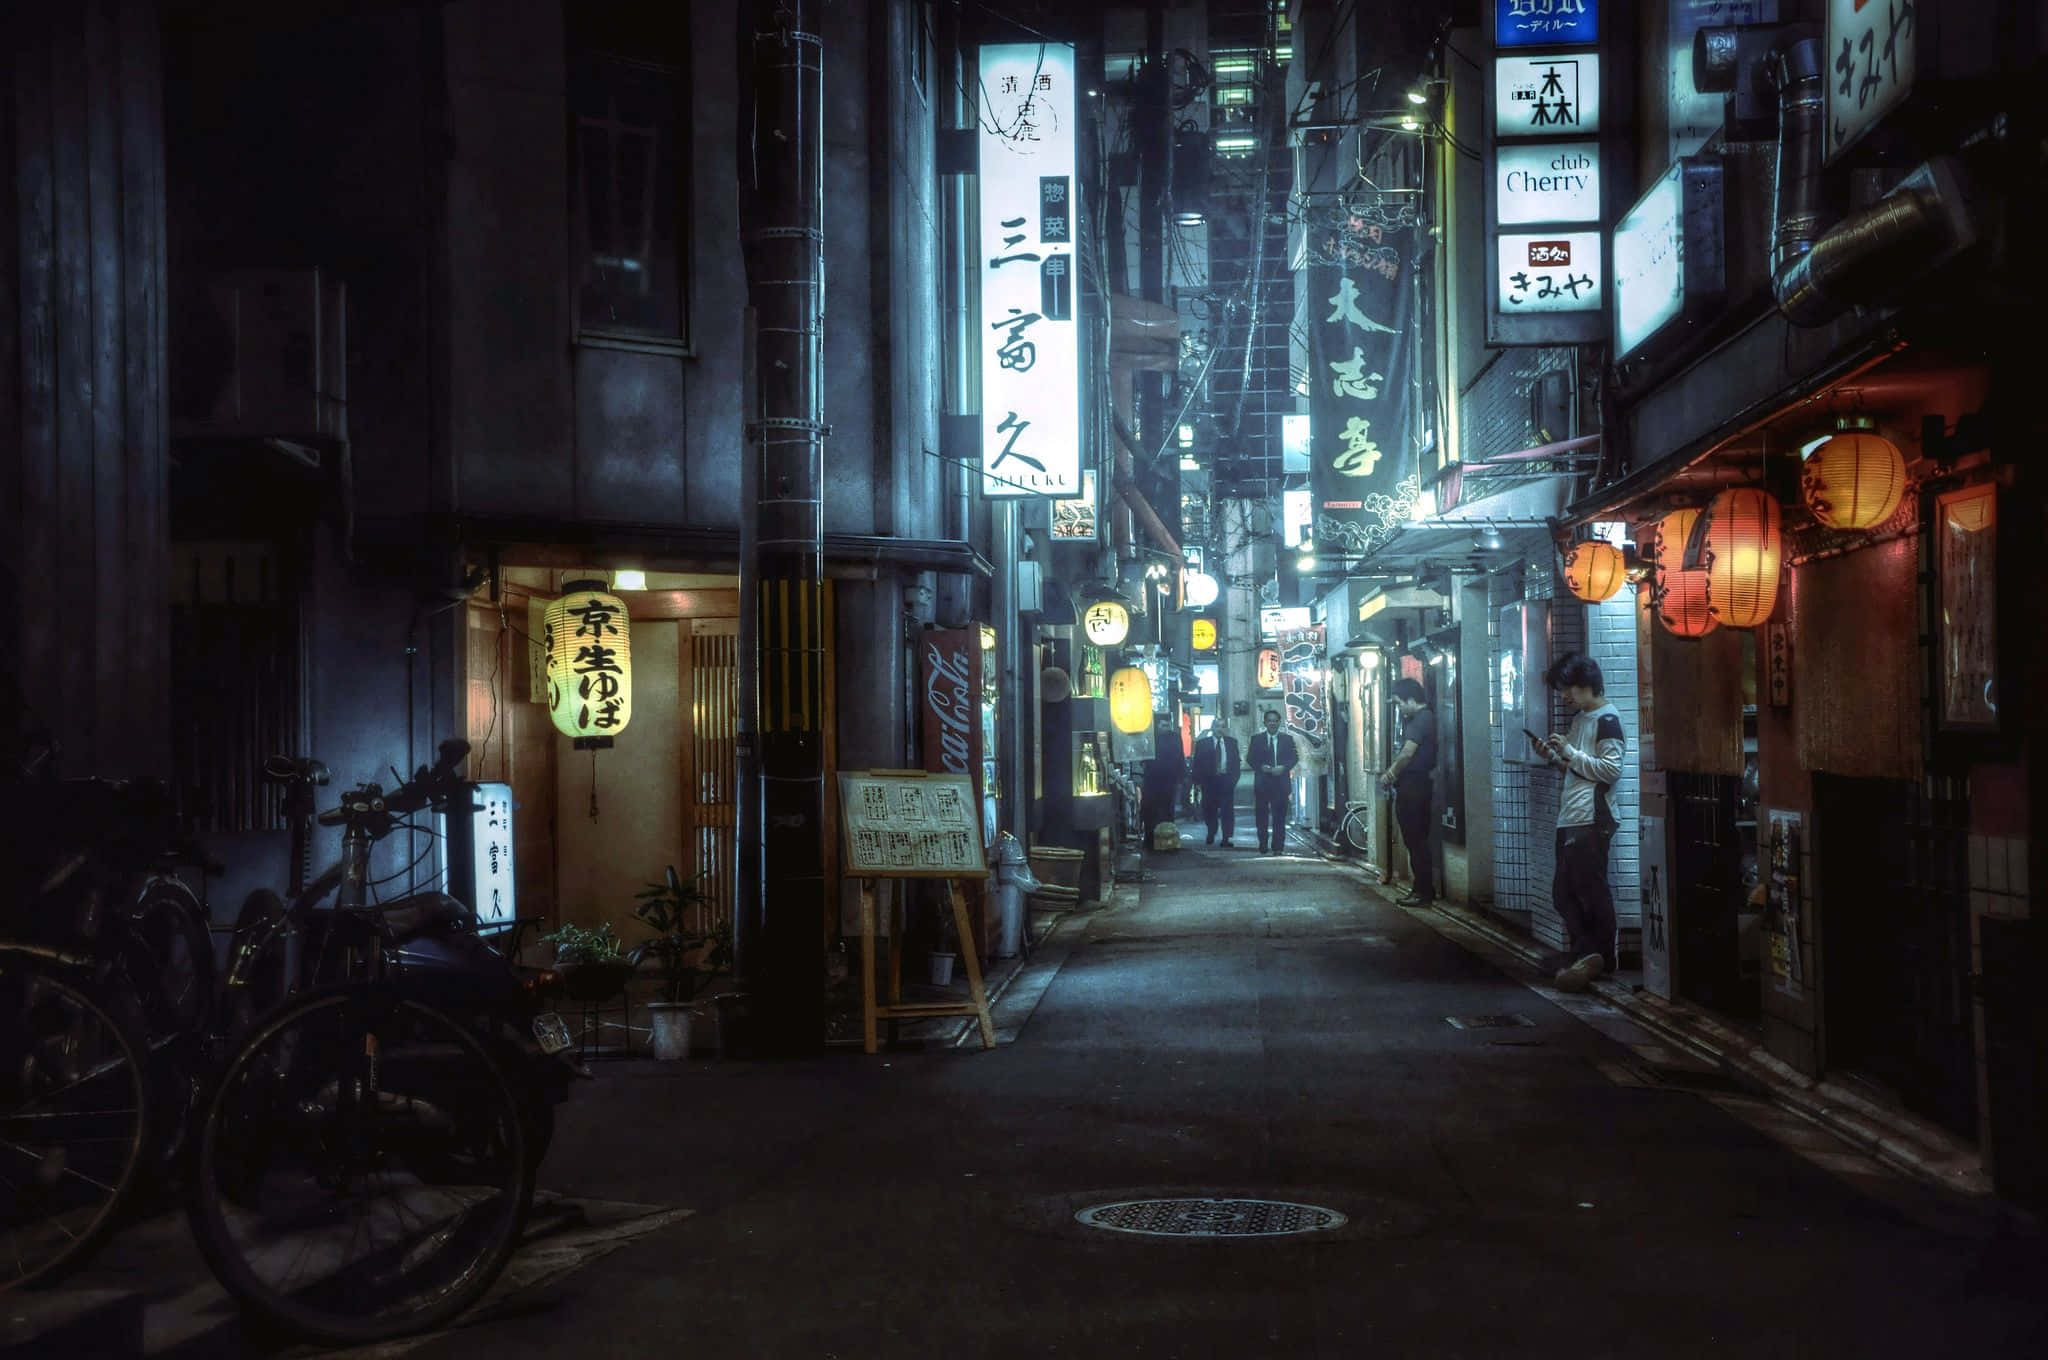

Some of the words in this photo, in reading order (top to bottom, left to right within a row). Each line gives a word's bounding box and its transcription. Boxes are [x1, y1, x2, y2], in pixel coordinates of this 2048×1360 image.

[1551, 153, 1590, 171] club
[1507, 171, 1588, 198] Cherry
[1530, 246, 1569, 262] 酒処
[1508, 271, 1594, 304] きみや
